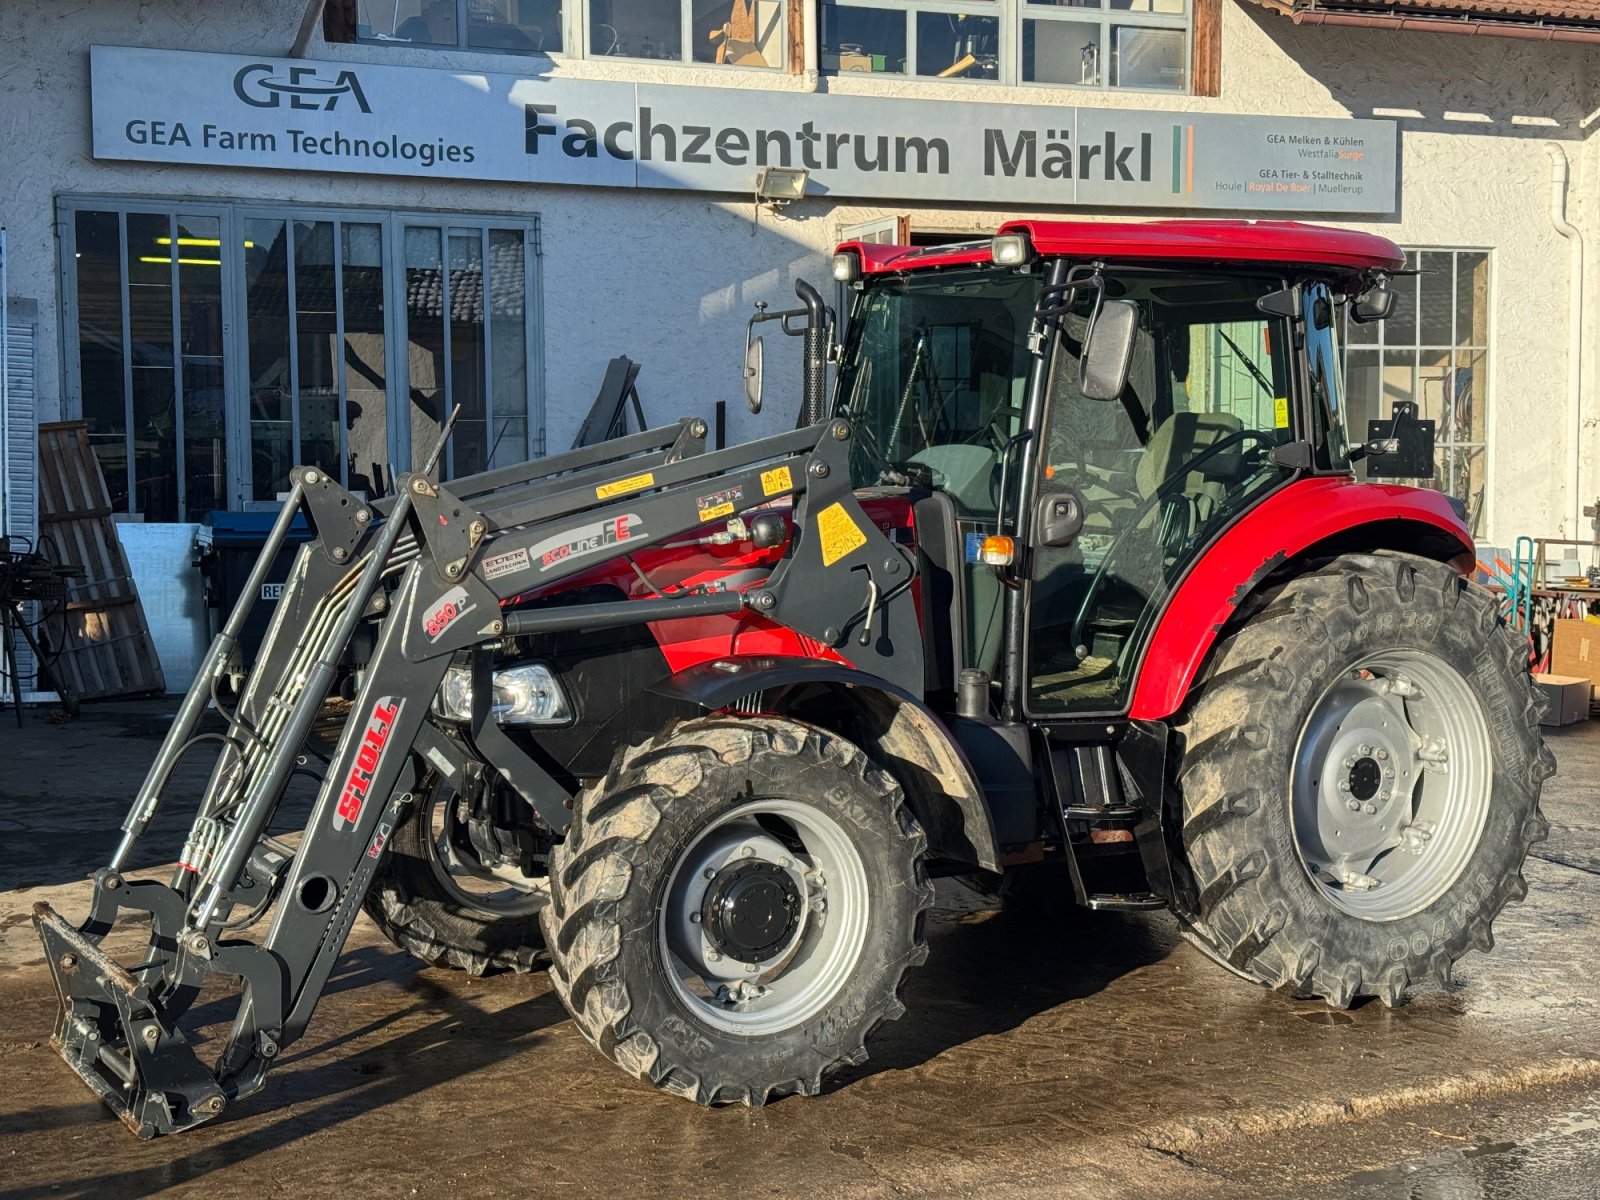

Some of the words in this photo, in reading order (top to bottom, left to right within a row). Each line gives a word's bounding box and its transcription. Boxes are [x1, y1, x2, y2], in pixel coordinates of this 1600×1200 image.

[232, 63, 373, 114] GEA
[125, 119, 192, 148] GEA
[203, 123, 277, 152] Farm
[287, 128, 475, 168] Technologies
[525, 103, 950, 175] Fachzentrum
[984, 127, 1152, 183] Märkl
[1267, 134, 1286, 144] GEA
[1289, 135, 1321, 145] Melken
[1324, 136, 1330, 145] &
[1333, 135, 1364, 147] Kühlen
[1215, 181, 1242, 191] Houle
[1249, 182, 1273, 193] Royal
[1276, 182, 1288, 192] De
[1290, 182, 1312, 193] Boer
[1318, 183, 1363, 195] Muellerup
[1259, 169, 1278, 179] GEA
[1281, 169, 1300, 179] Tier-
[1303, 170, 1309, 179] &
[1312, 170, 1363, 181] Stalltechnik
[602, 515, 631, 546] FE
[485, 551, 524, 568] EDER
[485, 559, 528, 575] LANDTECHNIK
[426, 602, 457, 637] 850
[1376, 612, 1393, 632] R
[1399, 610, 1434, 629] 34
[338, 703, 398, 824] STOLL
[1387, 872, 1497, 962] TM700
